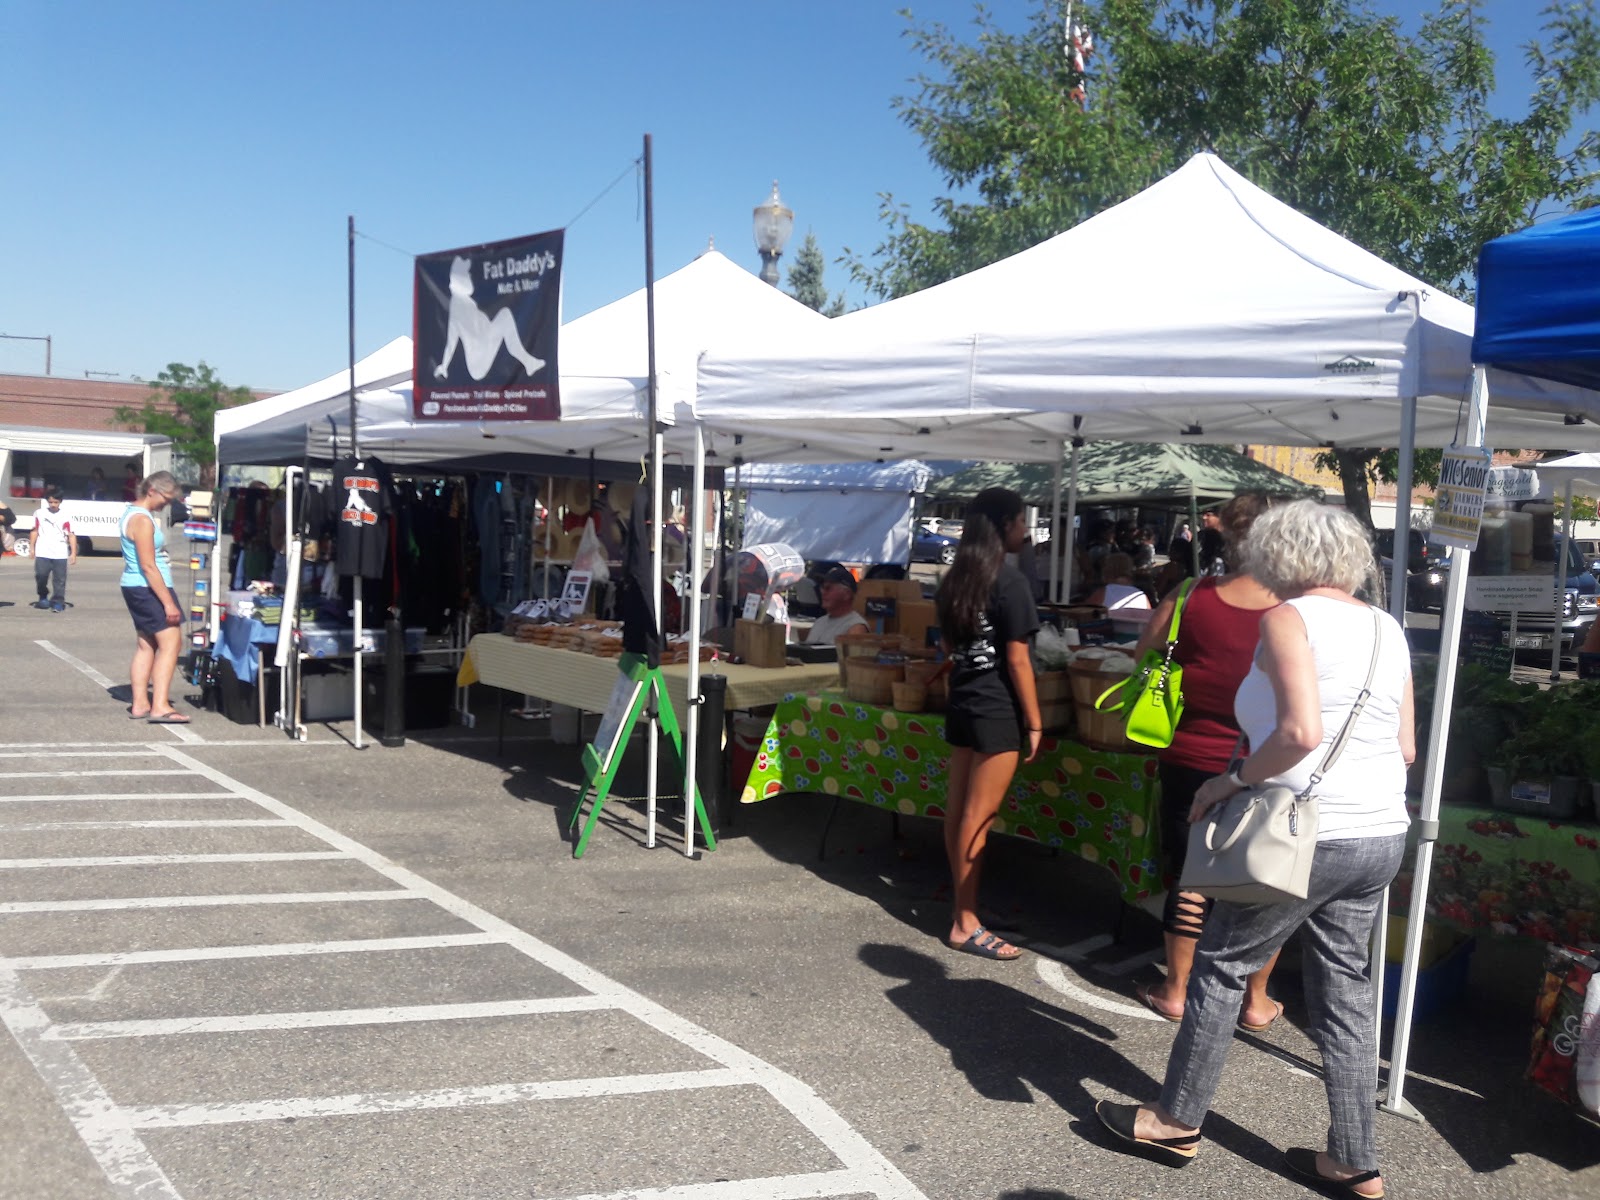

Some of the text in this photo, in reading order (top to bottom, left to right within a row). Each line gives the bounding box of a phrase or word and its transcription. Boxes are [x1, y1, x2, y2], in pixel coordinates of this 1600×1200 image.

[483, 250, 556, 280] Fat Daddy's
[1499, 486, 1531, 497] Soaps
[1453, 503, 1481, 518] MARKET
